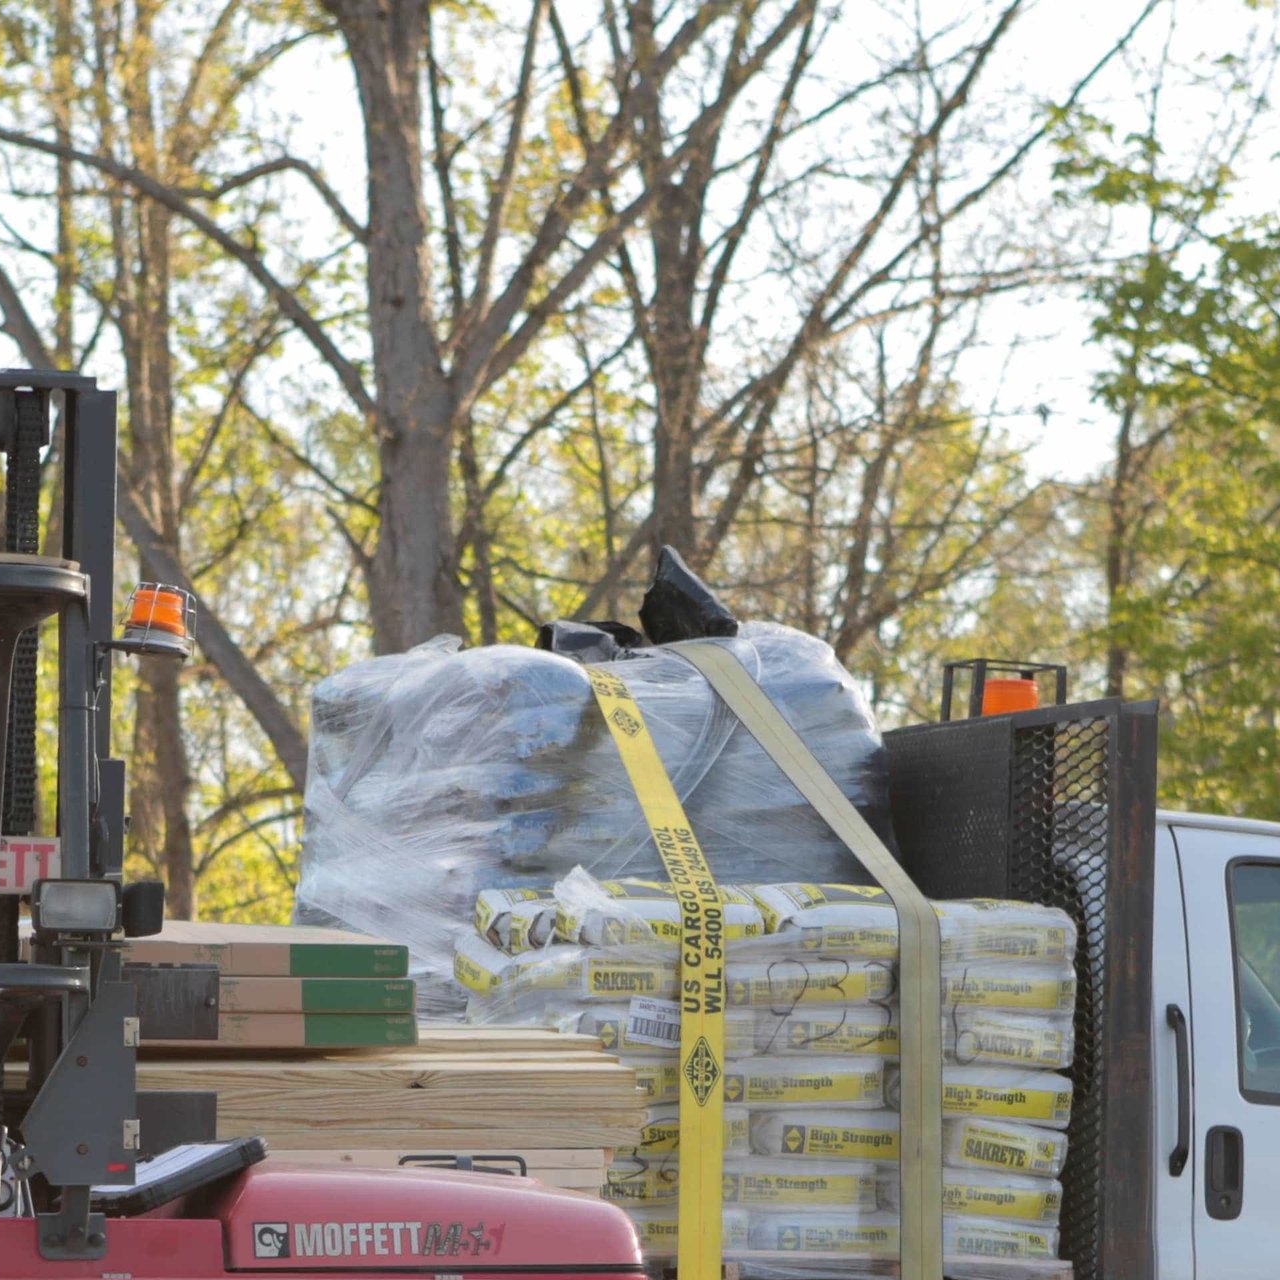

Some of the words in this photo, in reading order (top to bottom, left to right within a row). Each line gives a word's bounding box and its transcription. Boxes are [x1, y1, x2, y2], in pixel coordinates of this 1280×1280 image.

[674, 828, 694, 844] KG
[654, 826, 688, 889] CONTROL
[682, 842, 706, 873] 2449
[695, 880, 718, 903] LBS
[680, 890, 702, 967] CARGO
[704, 908, 722, 960] 5400
[593, 971, 655, 992] SAKRETE
[704, 967, 722, 1014] WLL
[982, 981, 1032, 996] Strength
[684, 980, 701, 1014] US
[782, 1076, 833, 1091] Strength
[944, 1086, 972, 1102] High
[976, 1088, 1027, 1105] Strength
[810, 1128, 838, 1144] High
[842, 1131, 893, 1147] Strength
[964, 1137, 1026, 1168] SAKRETE
[776, 1177, 828, 1192] Strength
[965, 1188, 1016, 1206] Strength
[295, 1221, 422, 1257] MOFFETT
